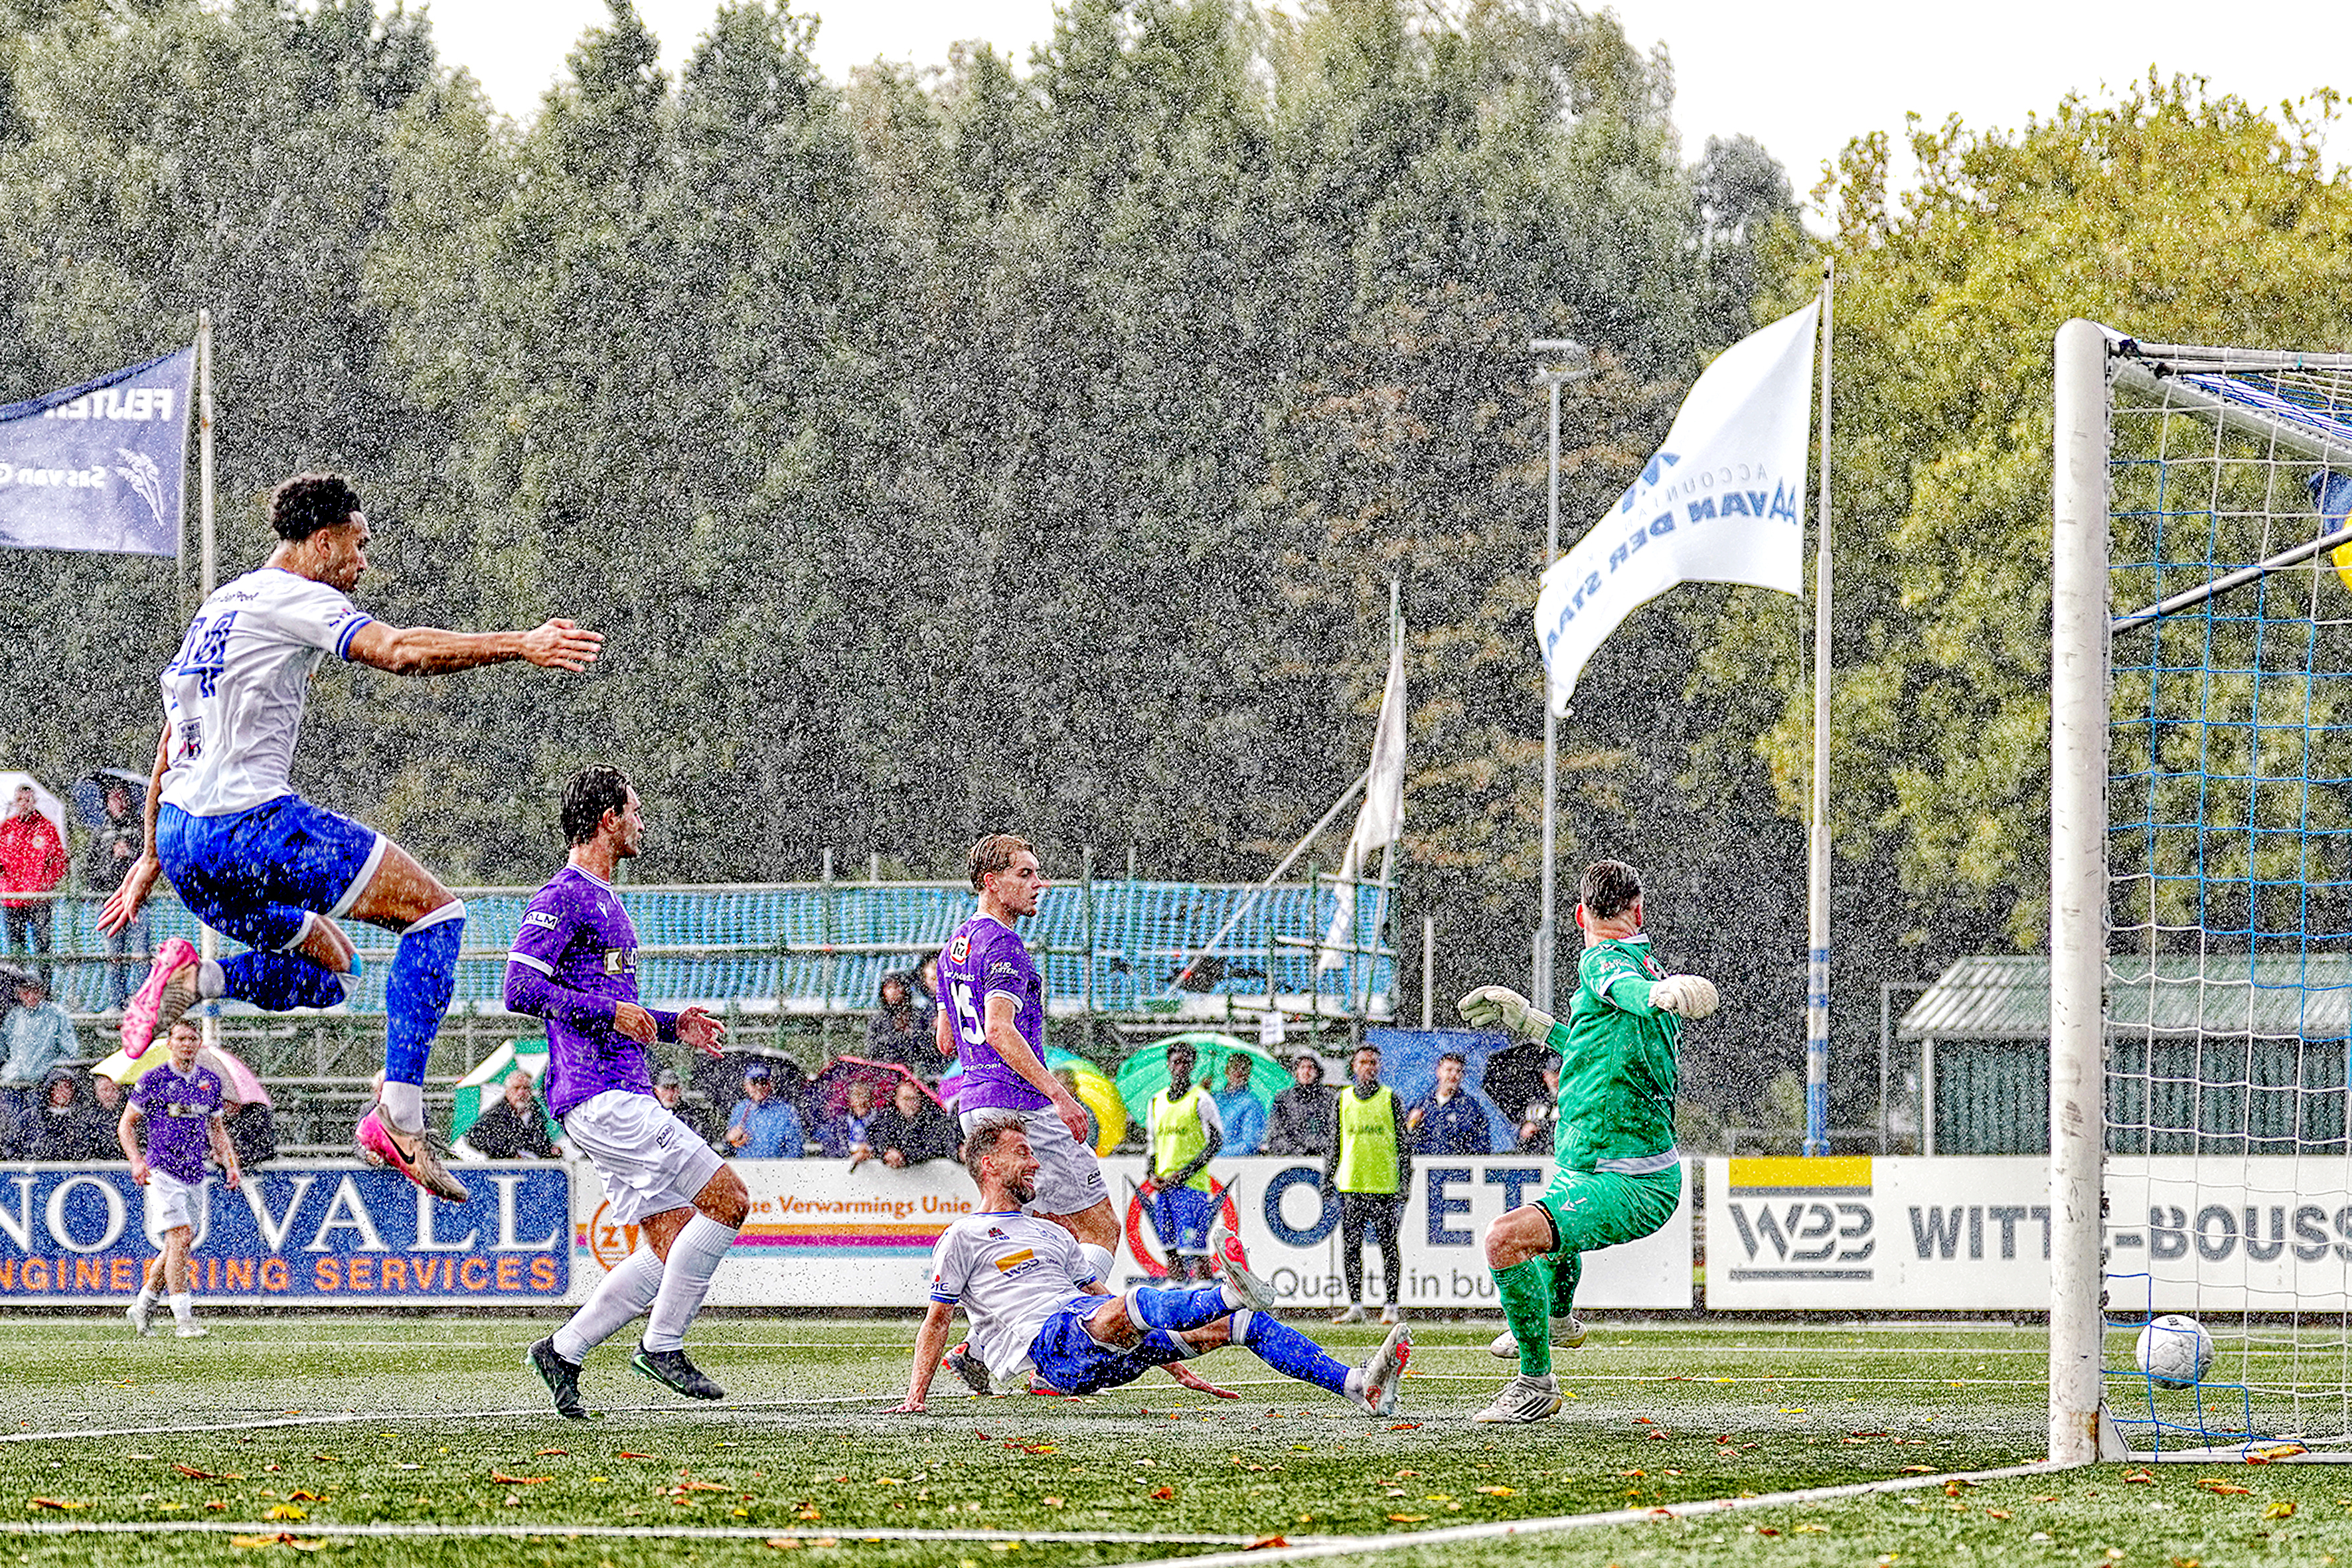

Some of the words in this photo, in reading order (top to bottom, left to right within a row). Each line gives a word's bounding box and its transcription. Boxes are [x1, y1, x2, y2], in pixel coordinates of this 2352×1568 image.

[950, 980, 986, 1046] 15
[779, 1195, 913, 1219] Verwarmings
[921, 1194, 971, 1214] Unie
[1264, 1166, 1542, 1246] OET
[1728, 1202, 1876, 1262] WBB
[314, 1257, 556, 1291] SERVICES
[1409, 1267, 1439, 1297] in
